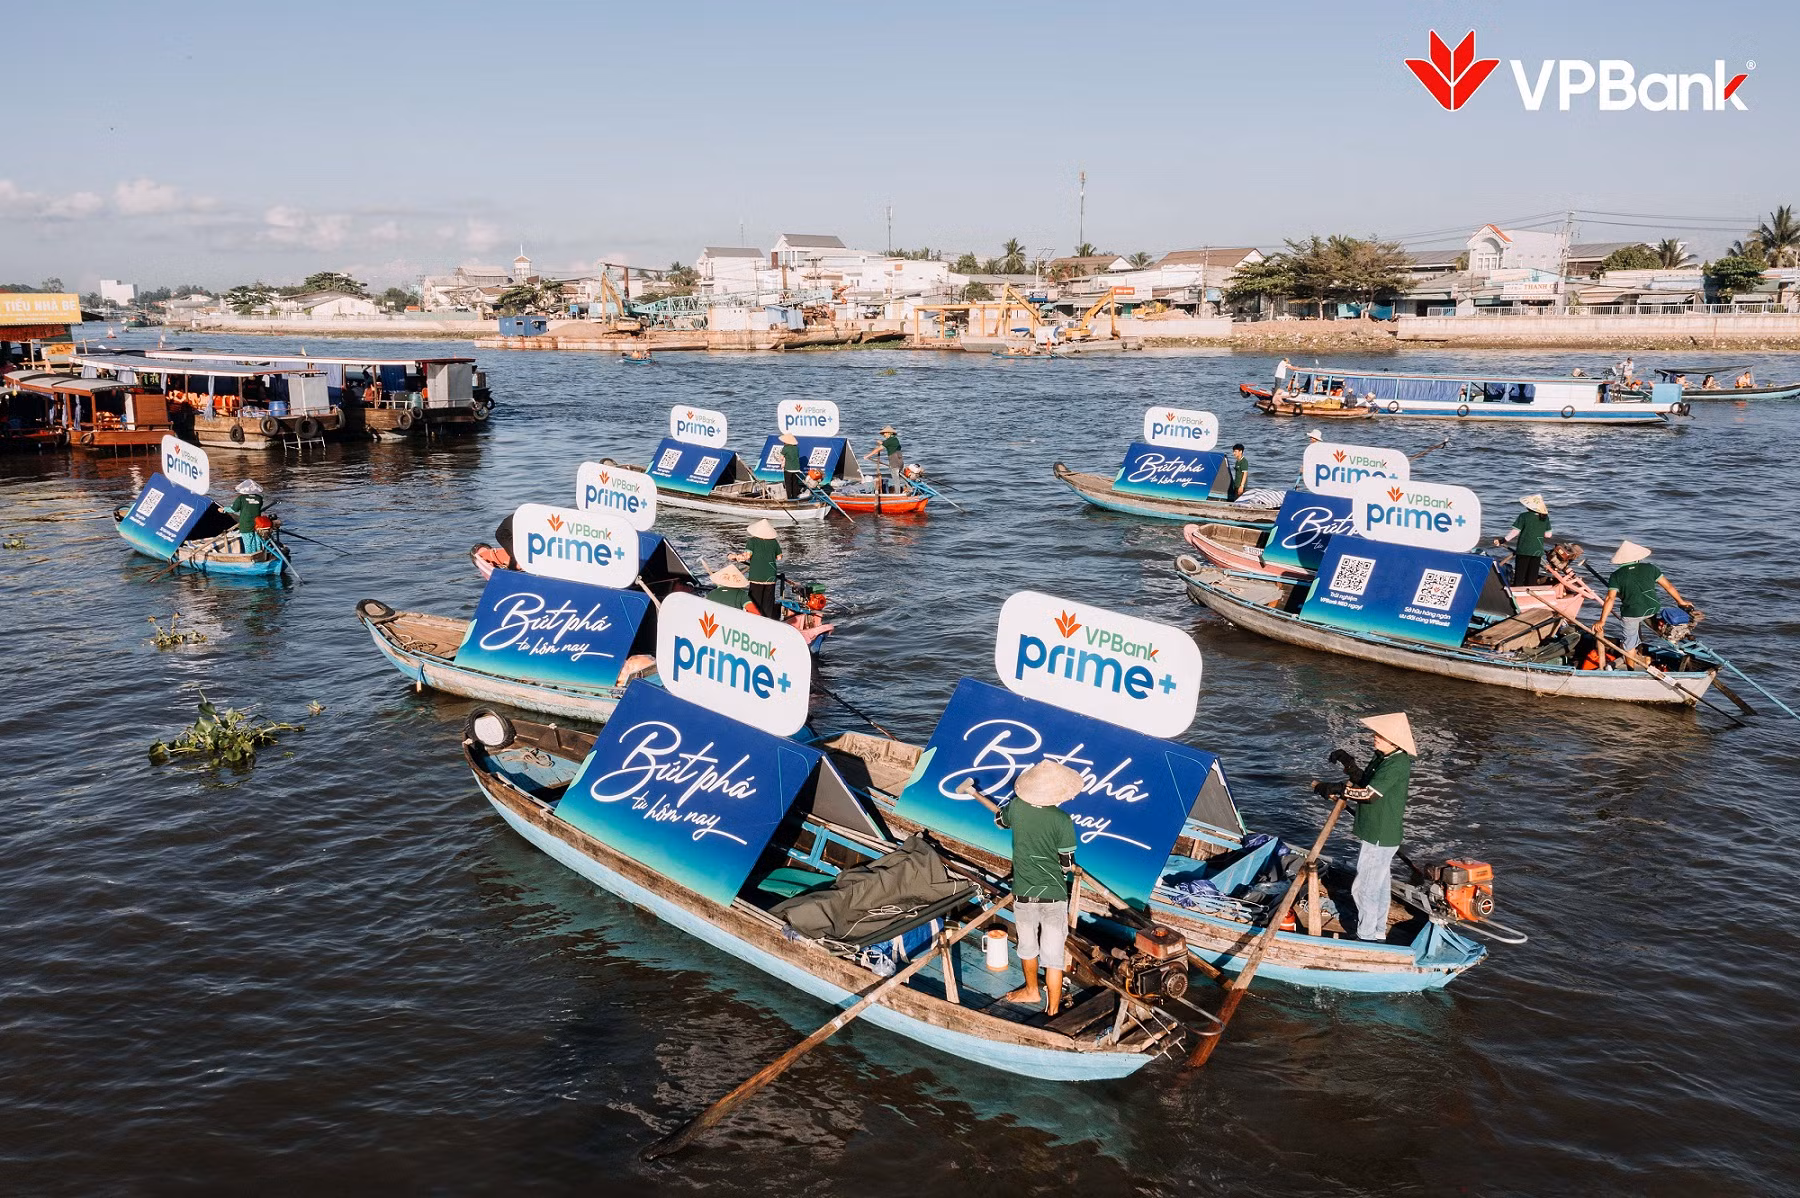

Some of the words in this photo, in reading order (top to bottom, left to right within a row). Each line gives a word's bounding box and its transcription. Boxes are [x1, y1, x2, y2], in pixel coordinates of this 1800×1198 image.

[1152, 422, 1210, 440] prime+
[1176, 415, 1204, 425] VPBank
[1349, 455, 1388, 469] VPBank
[585, 484, 648, 513] prime+
[611, 477, 640, 494] VPBank
[1406, 492, 1453, 510] VPBank
[566, 521, 612, 541] VPBank
[1366, 502, 1466, 533] prime+
[527, 532, 625, 567] prime+
[553, 603, 612, 644] phá
[561, 643, 614, 661] nay
[722, 625, 776, 662] VPBank
[1084, 624, 1159, 663] VPBank
[673, 635, 791, 699] prime+
[1015, 633, 1177, 700] prime+
[676, 754, 757, 808] phá
[643, 794, 683, 823] hôm
[684, 810, 748, 845] nay
